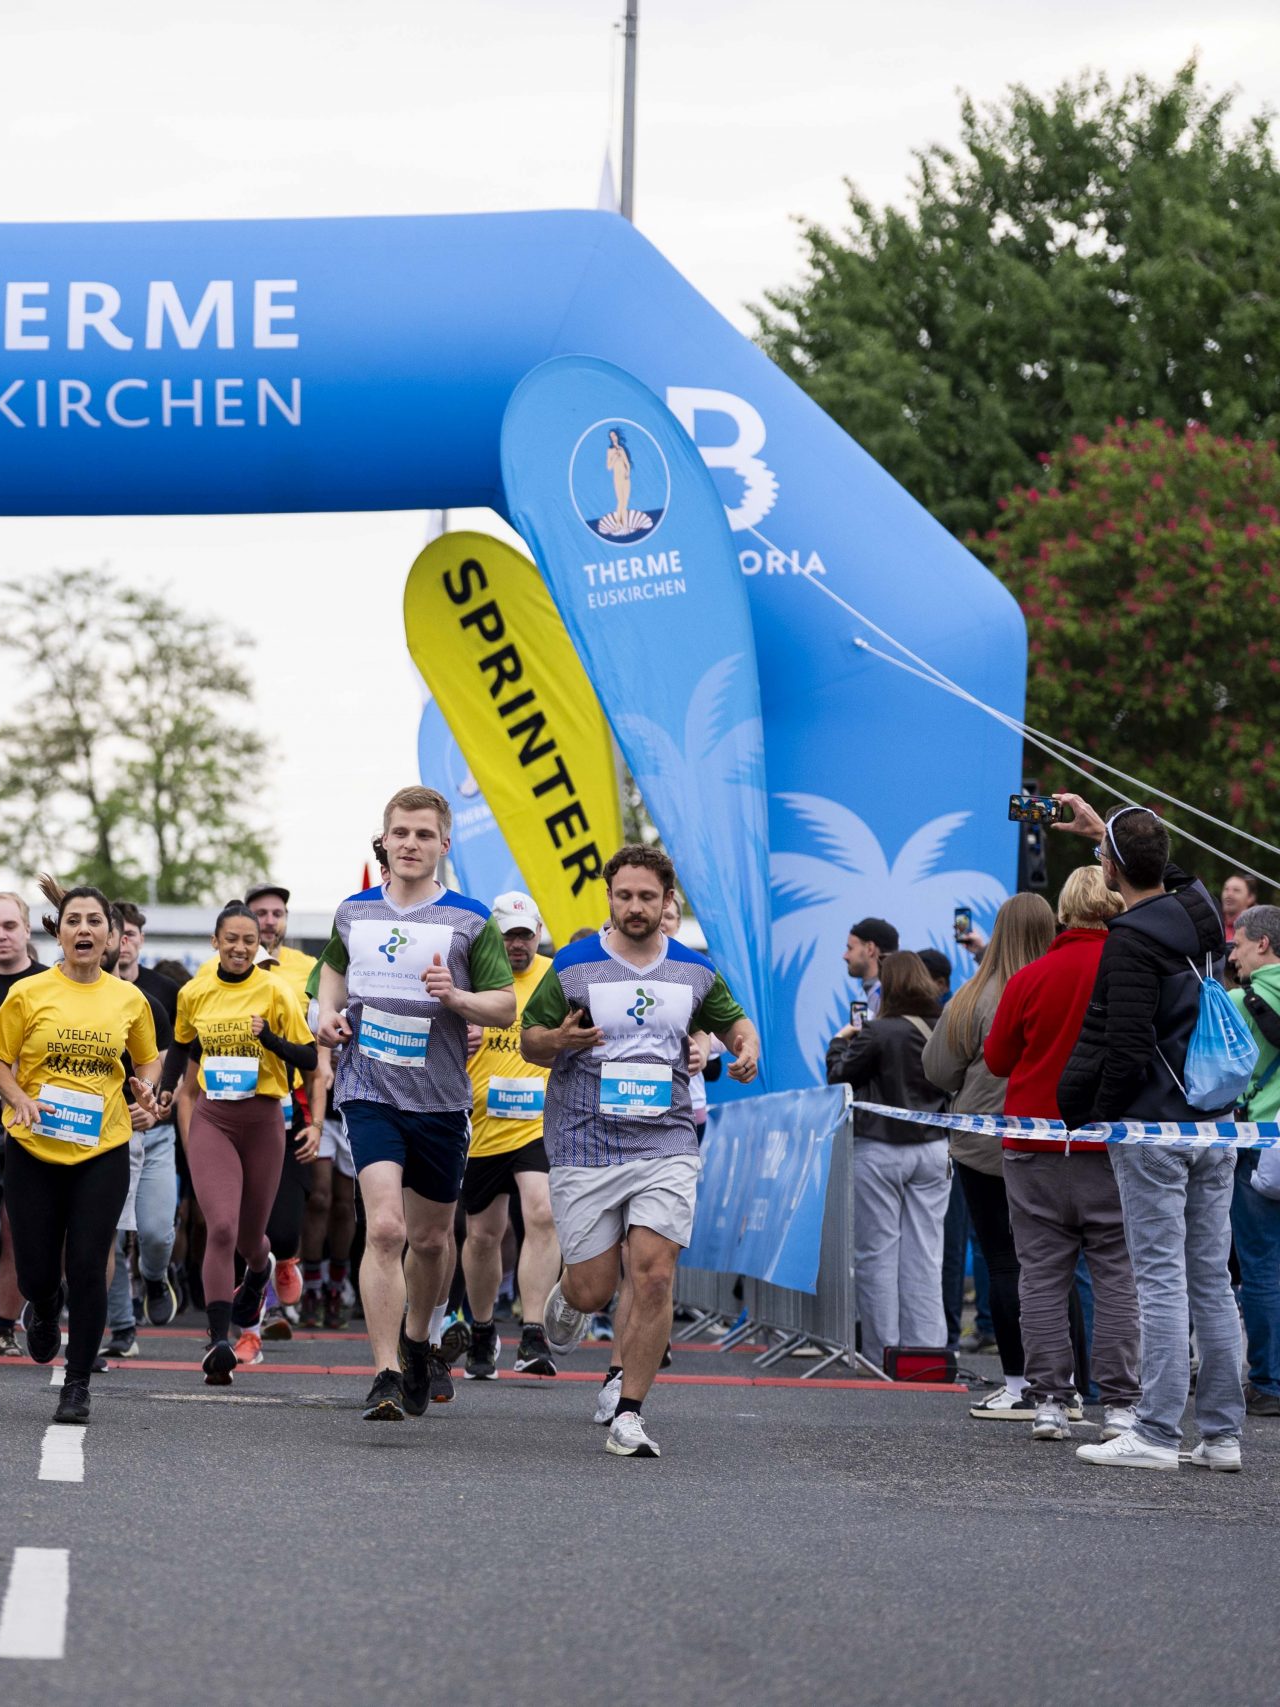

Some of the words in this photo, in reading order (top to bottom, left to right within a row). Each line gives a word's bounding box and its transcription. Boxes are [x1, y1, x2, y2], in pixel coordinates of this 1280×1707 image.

[583, 550, 683, 587] THERME
[738, 550, 827, 575] ORIA
[587, 579, 687, 609] EUSKIRCHEN
[442, 558, 603, 897] SPRINTER
[207, 1021, 251, 1033] VIELFALT
[57, 1028, 112, 1043] VIELFALT
[202, 1034, 236, 1045] BEWEGT
[361, 1023, 427, 1048] Maximilian
[47, 1042, 94, 1055] BEWEGT
[95, 1047, 118, 1058] UNS
[215, 1071, 241, 1083] Flora
[618, 1081, 657, 1096] Oliver
[498, 1091, 534, 1104] Harald
